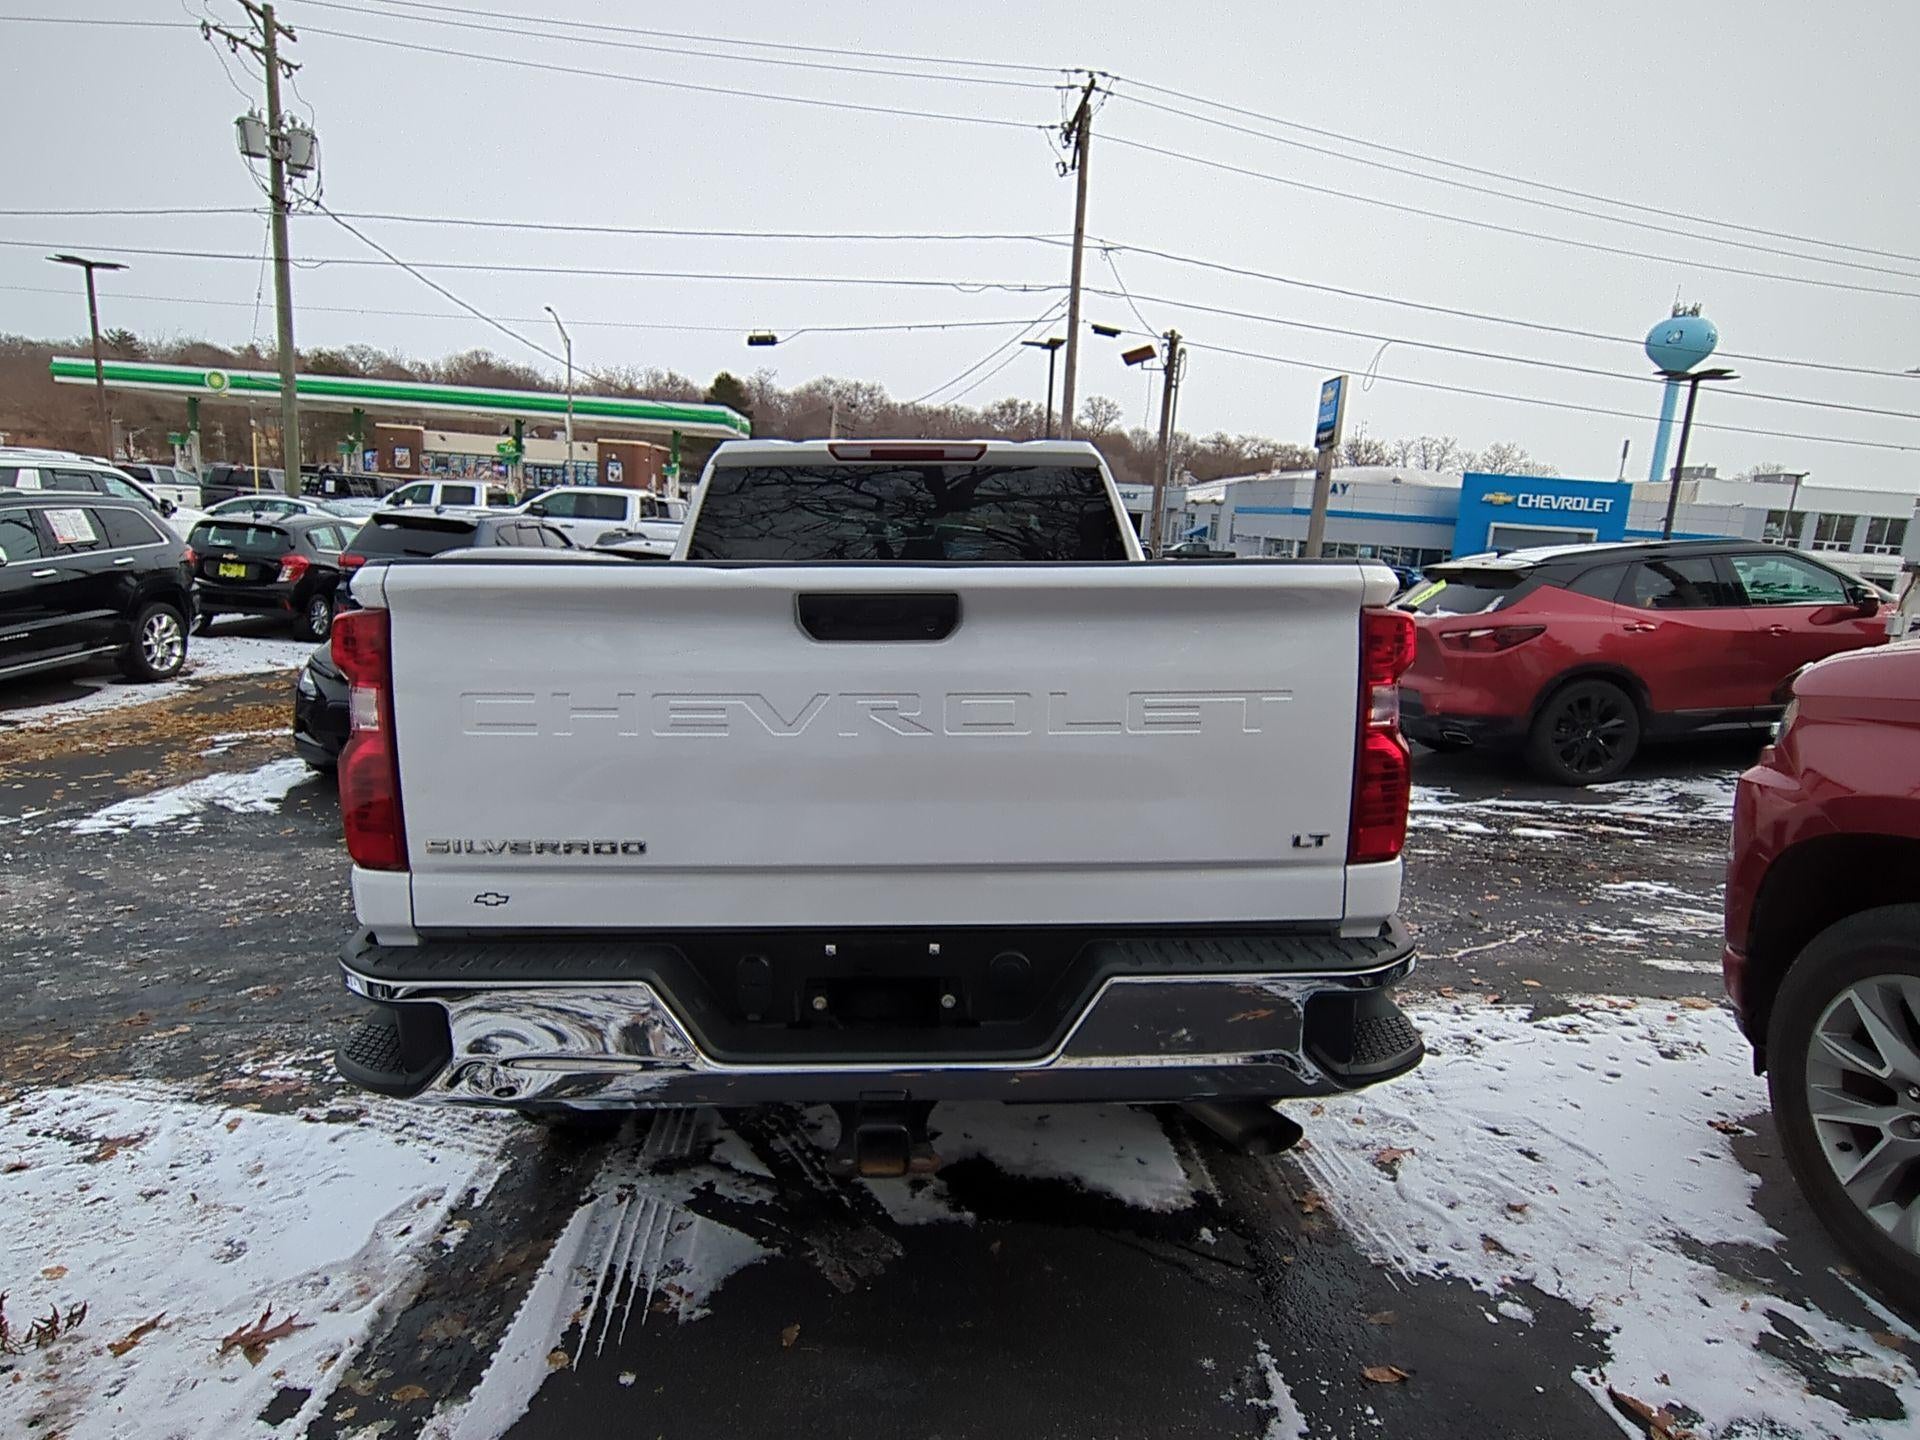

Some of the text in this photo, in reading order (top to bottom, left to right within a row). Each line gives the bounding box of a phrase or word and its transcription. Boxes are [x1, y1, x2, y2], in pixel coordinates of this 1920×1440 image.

[1329, 482, 1350, 495] AY
[1517, 493, 1615, 513] CHEVROLET
[460, 690, 1294, 738] CHEVROLET
[425, 839, 648, 856] SILVERADO
[1292, 833, 1331, 848] LT
